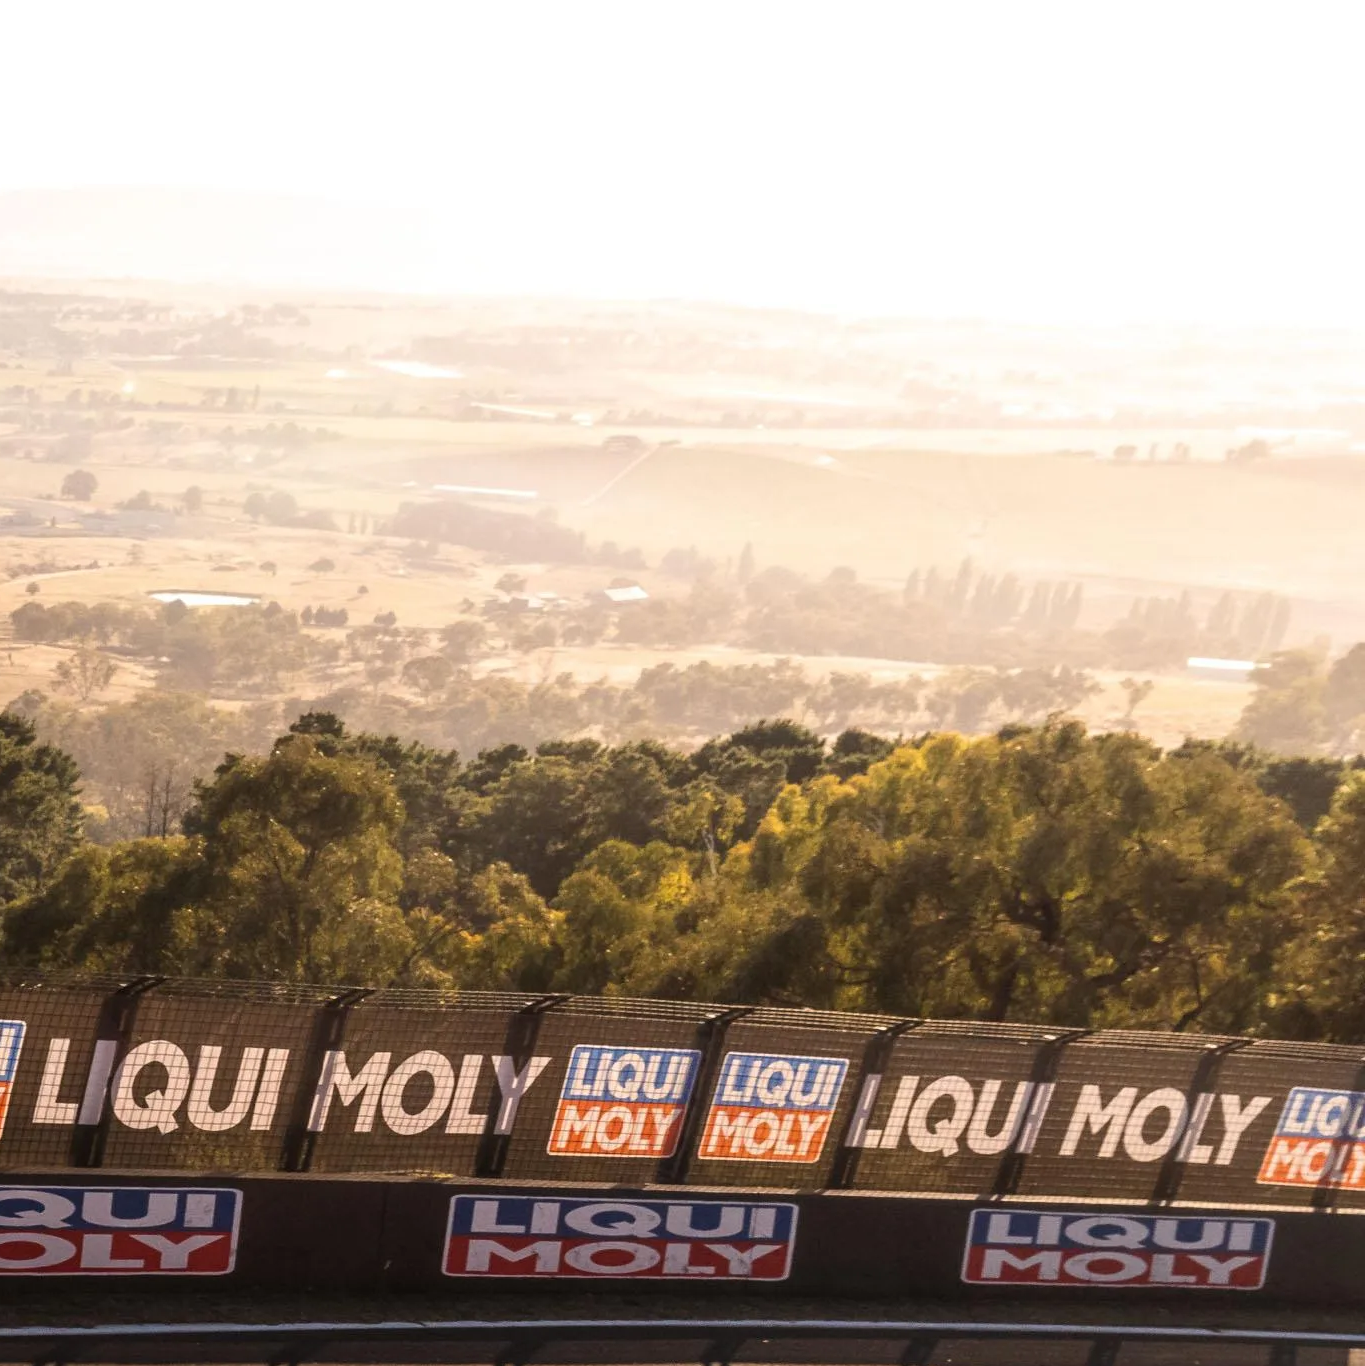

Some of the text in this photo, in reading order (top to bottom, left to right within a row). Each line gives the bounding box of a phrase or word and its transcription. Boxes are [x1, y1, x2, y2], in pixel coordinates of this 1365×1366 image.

[32, 1038, 554, 1136] LIQUI MOLY
[569, 1048, 692, 1103] LIQUI
[719, 1056, 842, 1110] LIQUI
[555, 1104, 683, 1153] MOLY
[706, 1110, 828, 1158] MOLY
[845, 1073, 1273, 1166] LIQUI MOLY
[470, 1200, 777, 1240] LIQUI
[985, 1213, 1258, 1252] LIQUI
[465, 1240, 783, 1276] MOLY
[980, 1249, 1267, 1285] MOLY
